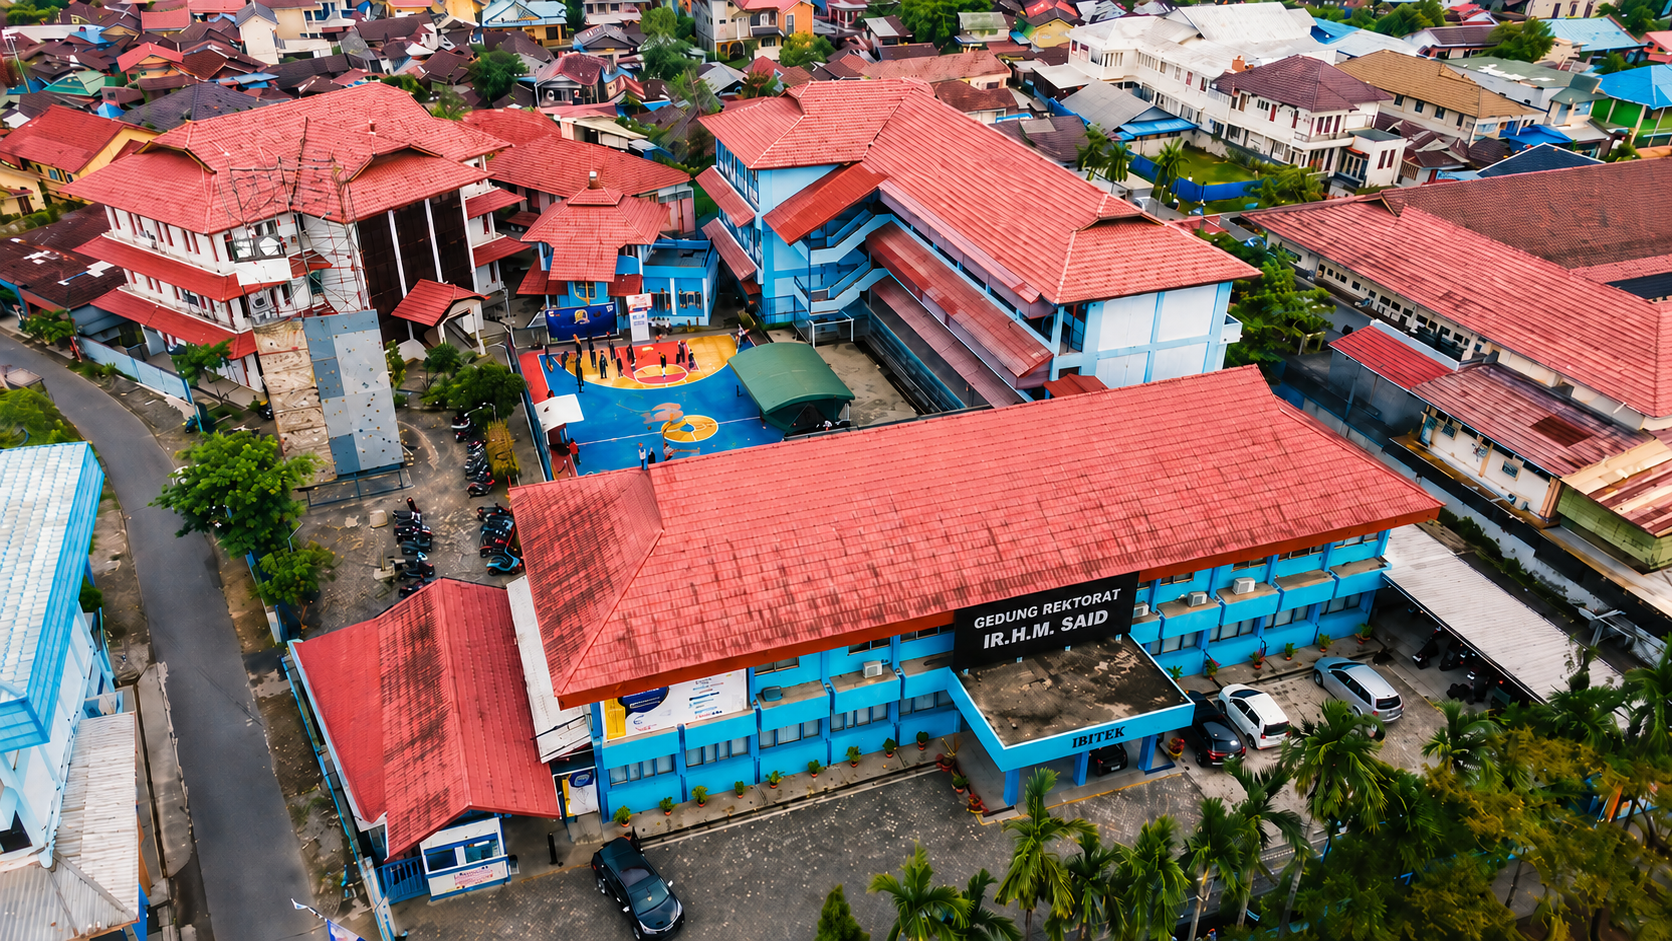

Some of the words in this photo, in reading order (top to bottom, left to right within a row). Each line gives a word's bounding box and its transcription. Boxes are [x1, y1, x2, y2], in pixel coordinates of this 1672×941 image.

[974, 606, 1038, 629] GEDUNG
[1042, 588, 1121, 615] REKTORAT
[983, 622, 1054, 649] IR.H.M.
[1060, 610, 1109, 632] SAID
[1072, 726, 1126, 749] IBITEK
